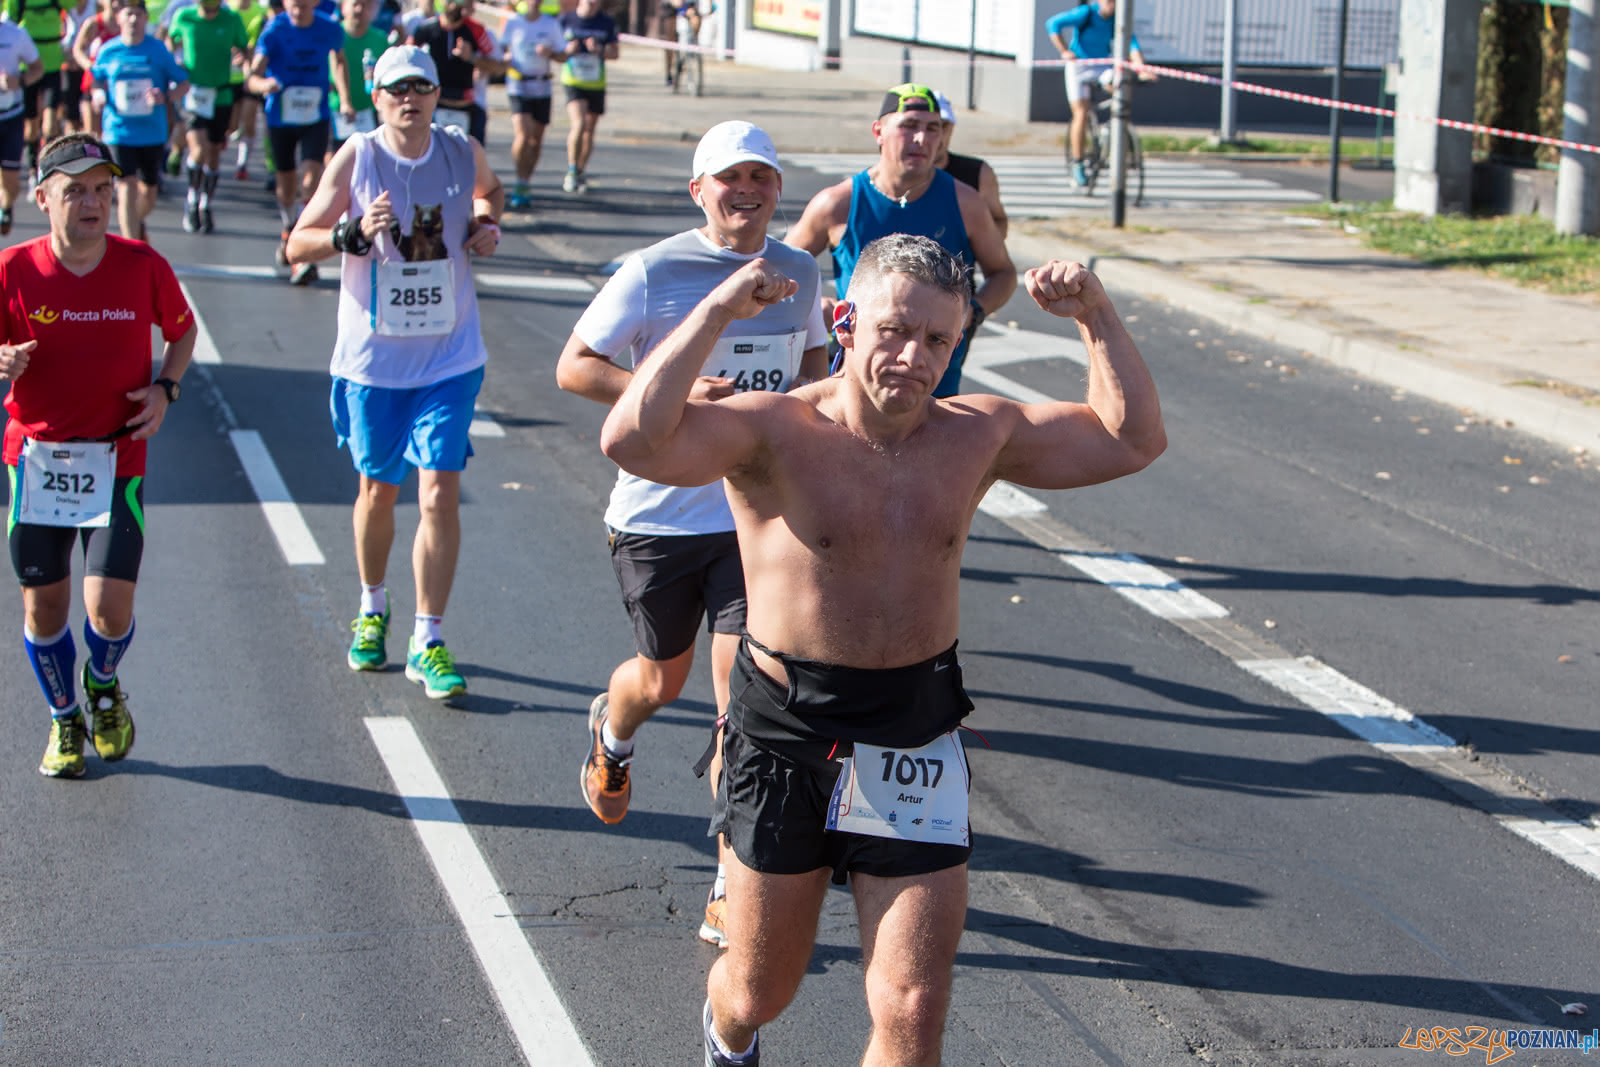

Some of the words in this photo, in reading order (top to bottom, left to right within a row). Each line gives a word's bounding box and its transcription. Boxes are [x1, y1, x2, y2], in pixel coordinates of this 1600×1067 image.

[390, 286, 442, 306] 2855
[63, 308, 99, 321] Poczta
[103, 308, 136, 320] Polska
[42, 471, 95, 494] 2512
[881, 751, 944, 789] 1017
[897, 793, 924, 805] Artur
